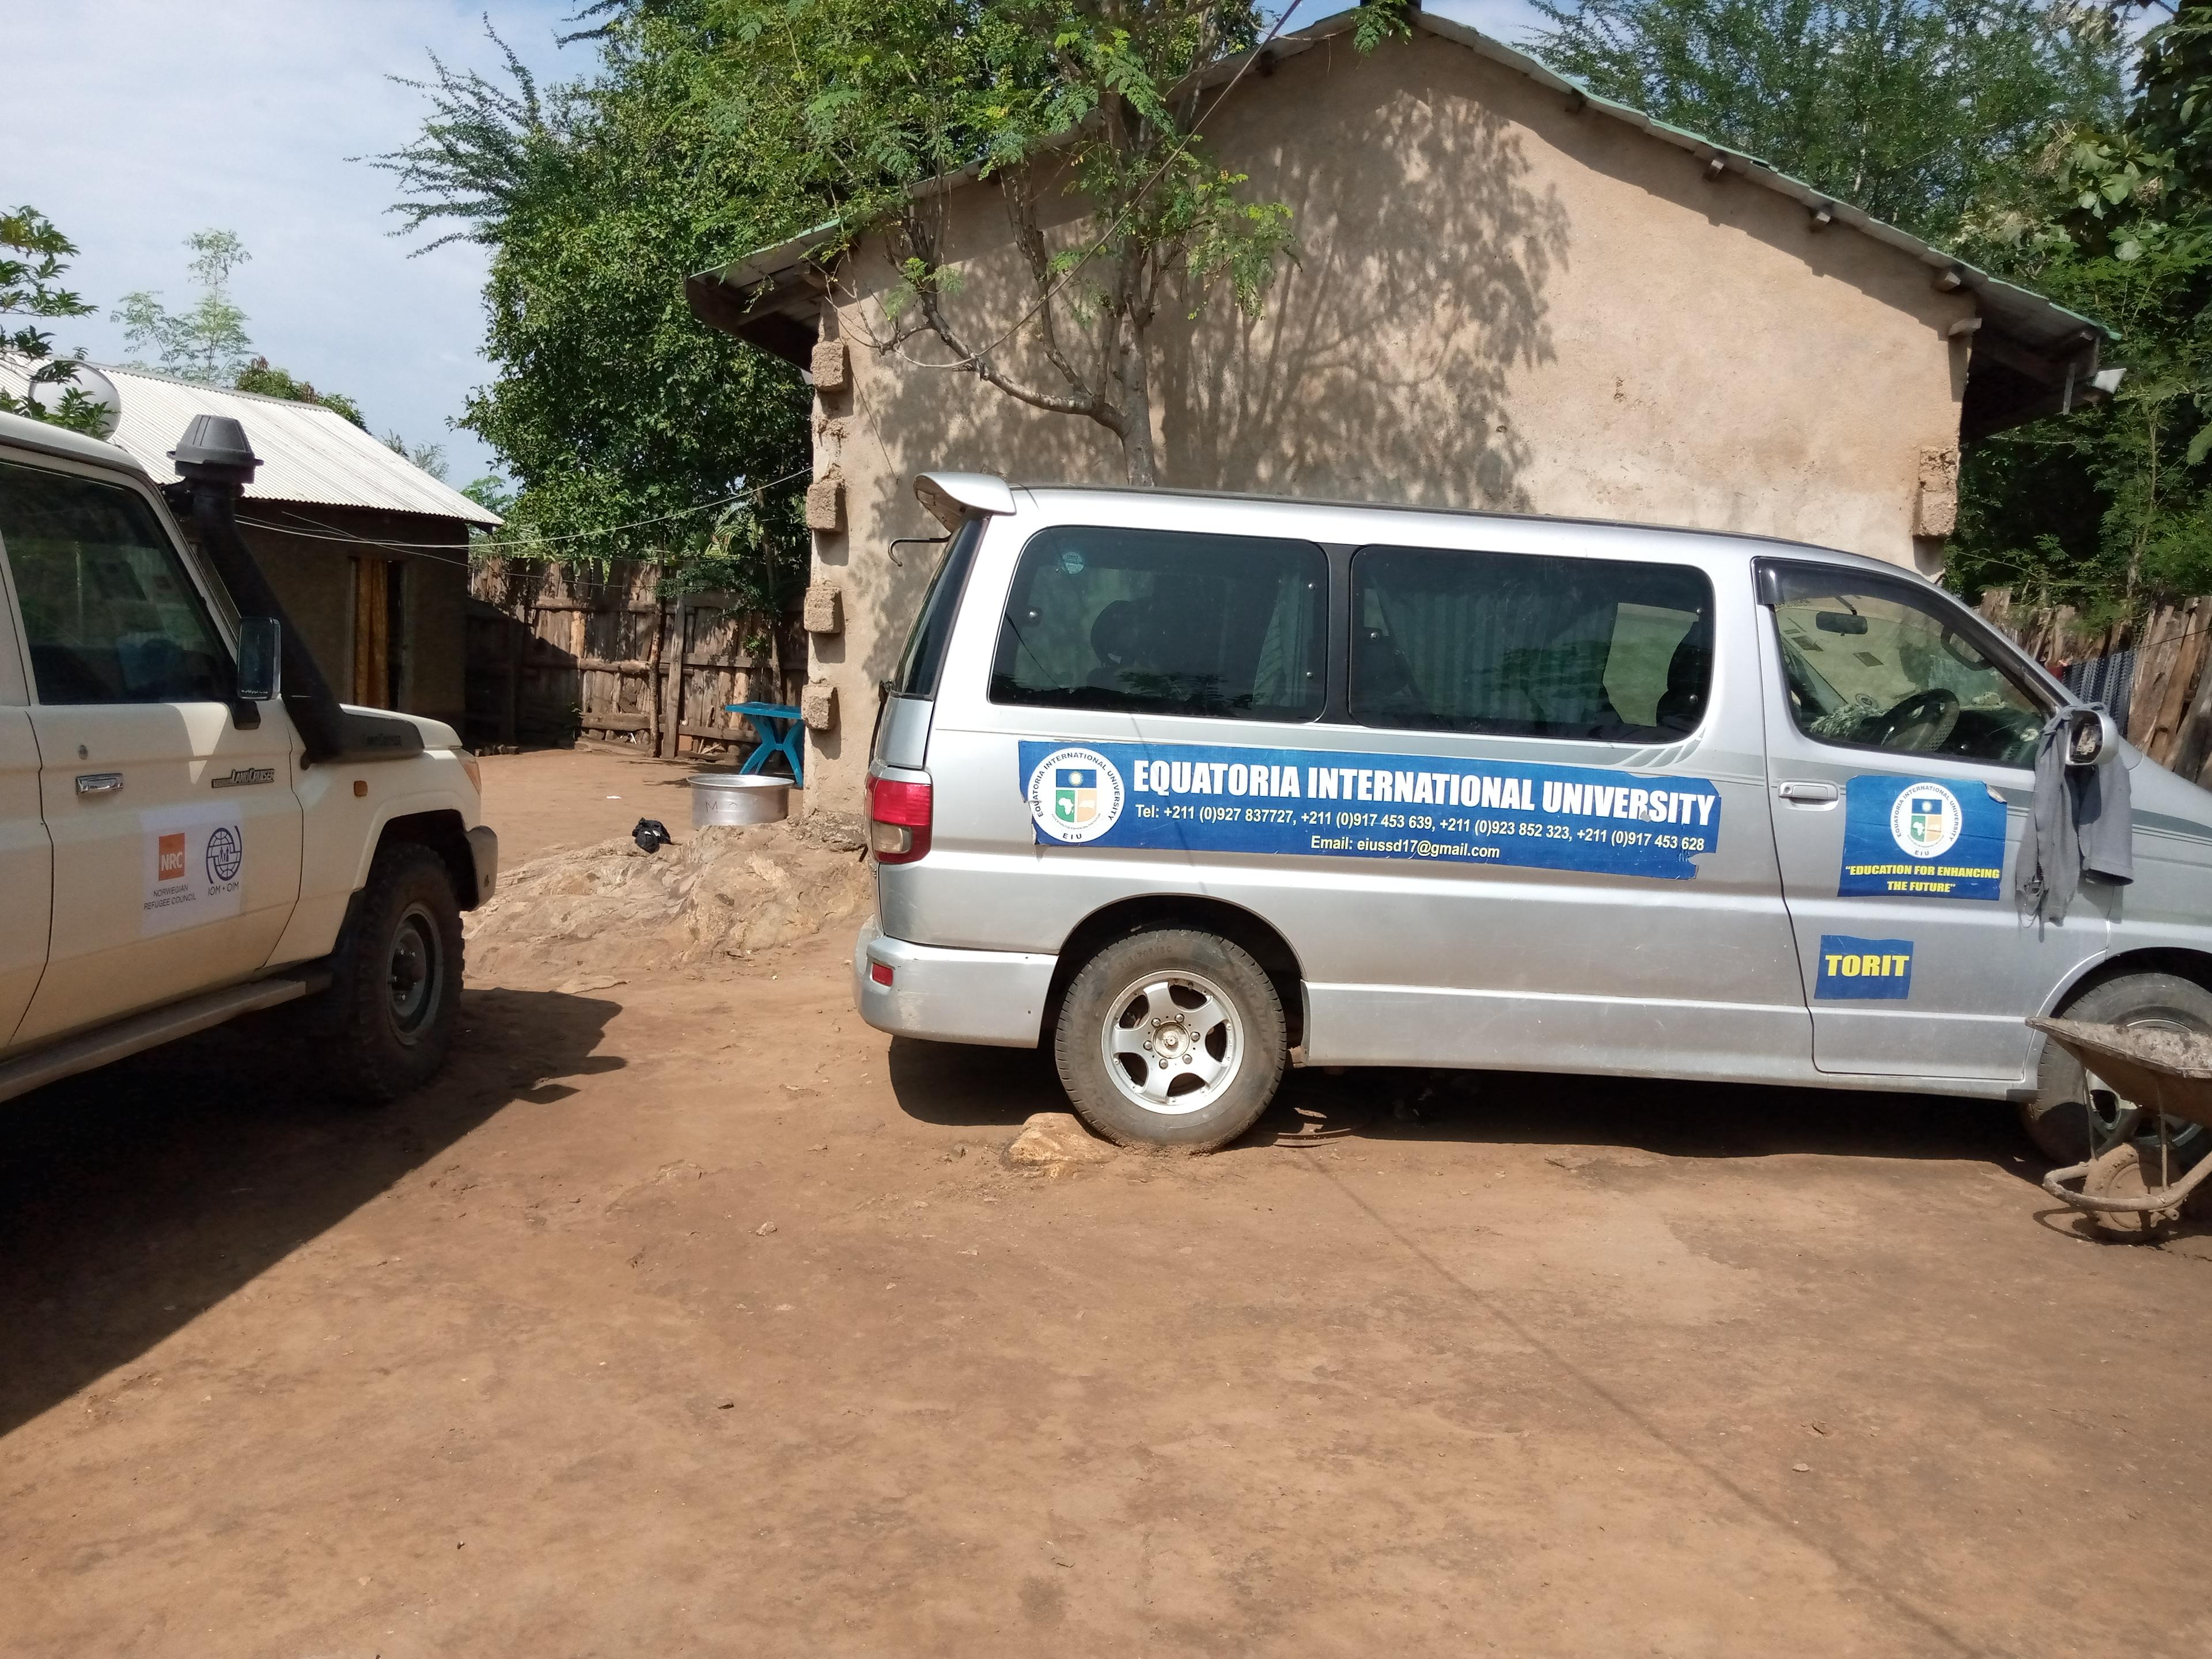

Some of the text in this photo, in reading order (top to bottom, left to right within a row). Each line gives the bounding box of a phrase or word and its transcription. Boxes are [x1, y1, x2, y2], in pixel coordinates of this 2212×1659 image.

[1032, 752, 1120, 821] EQUATORIA INTERNATIONAL UNIVERSITY
[1134, 760, 1716, 826] EQUATORIA INTERNATIONAL UNIVERSITY
[1893, 785, 1959, 841] EQUATORIA INTERNATIONAL UNIVERSITY
[1135, 804, 1705, 851] Tel: +211 (0)927 837727, +211 (0)917 453 639, +211 (0)923 852 323, +211 (0)917 453 628
[1310, 835, 1500, 858] Email: eiussd17@gmail.com
[161, 851, 183, 871] NRC
[1845, 865, 2000, 879] “EDUCATION FOR ENHANCING
[153, 884, 188, 897] NORWEGIAN
[208, 881, 239, 896] IOM OIM
[1887, 881, 1956, 893] THE FUTURE”
[144, 893, 196, 910] REFUGEE COUNCIL
[1825, 955, 1910, 977] TORIT
